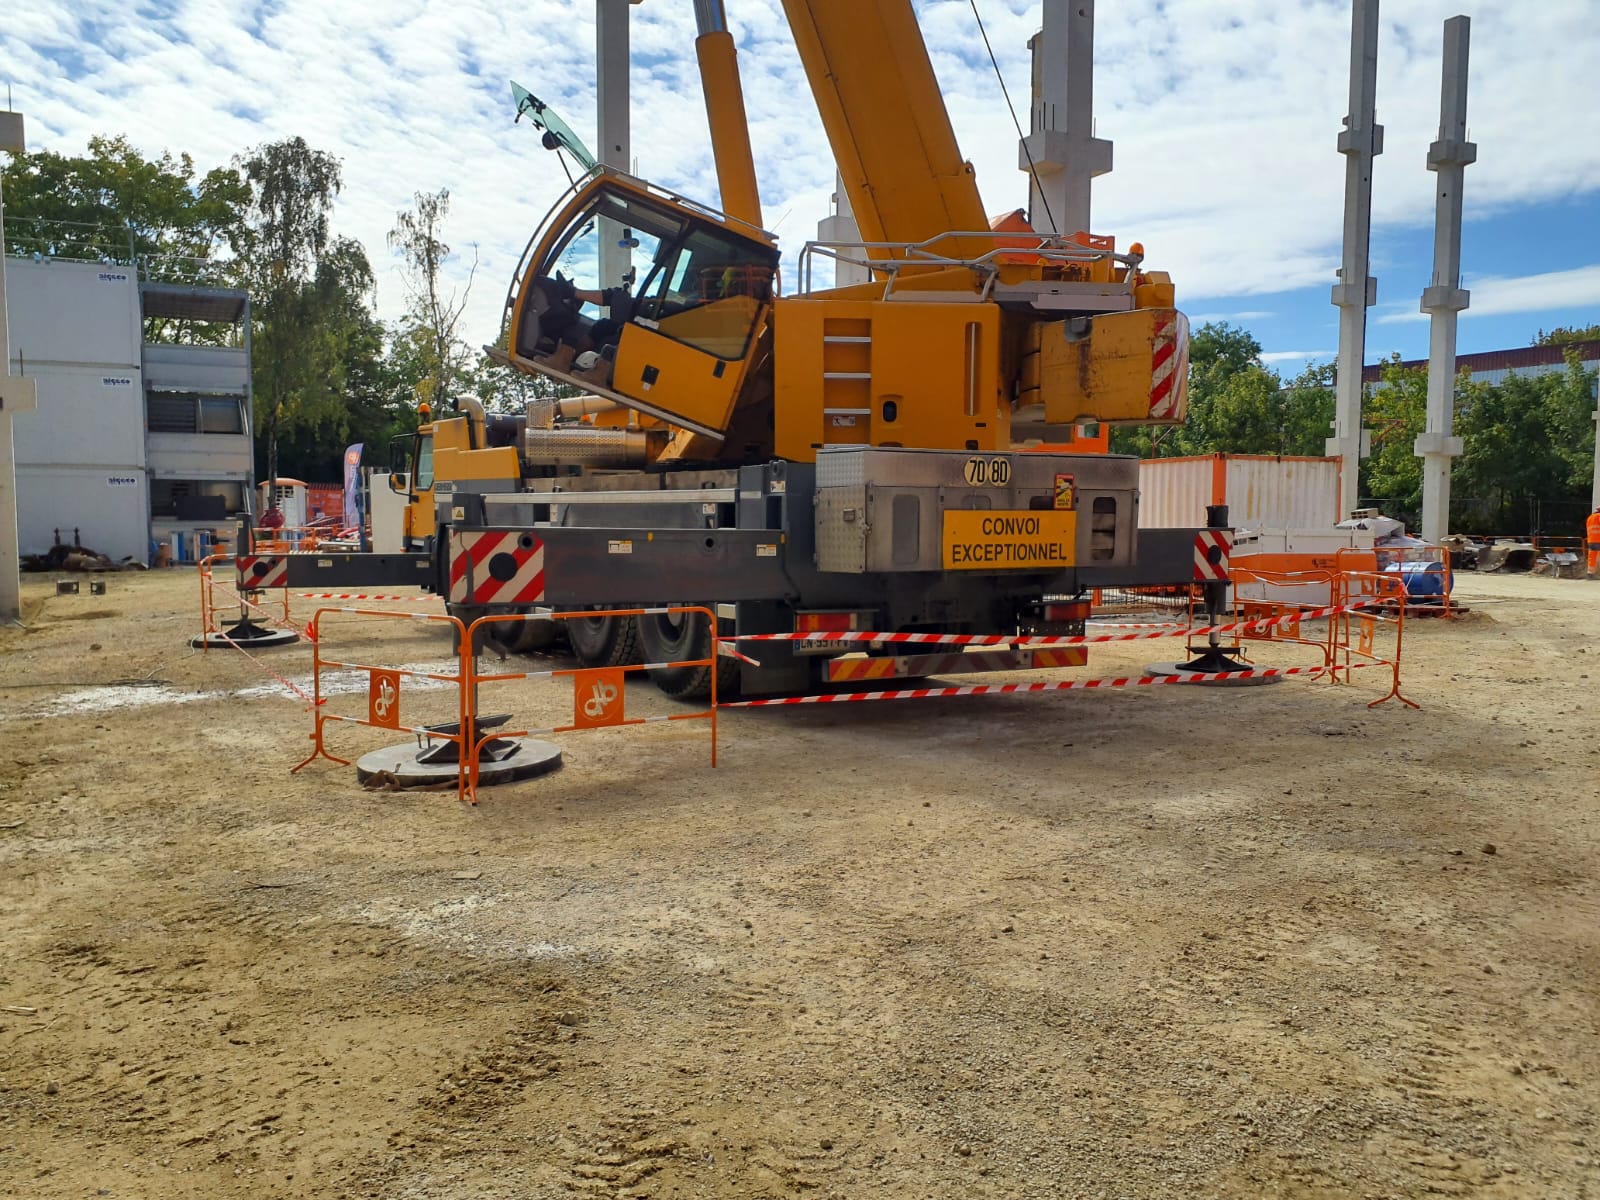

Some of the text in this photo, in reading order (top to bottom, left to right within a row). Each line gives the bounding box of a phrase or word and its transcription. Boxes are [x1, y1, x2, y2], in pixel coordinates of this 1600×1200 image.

[969, 460, 1008, 483] 70 80
[982, 517, 1040, 536] CONVOI
[952, 543, 1067, 563] EXCEPTIONNEL
